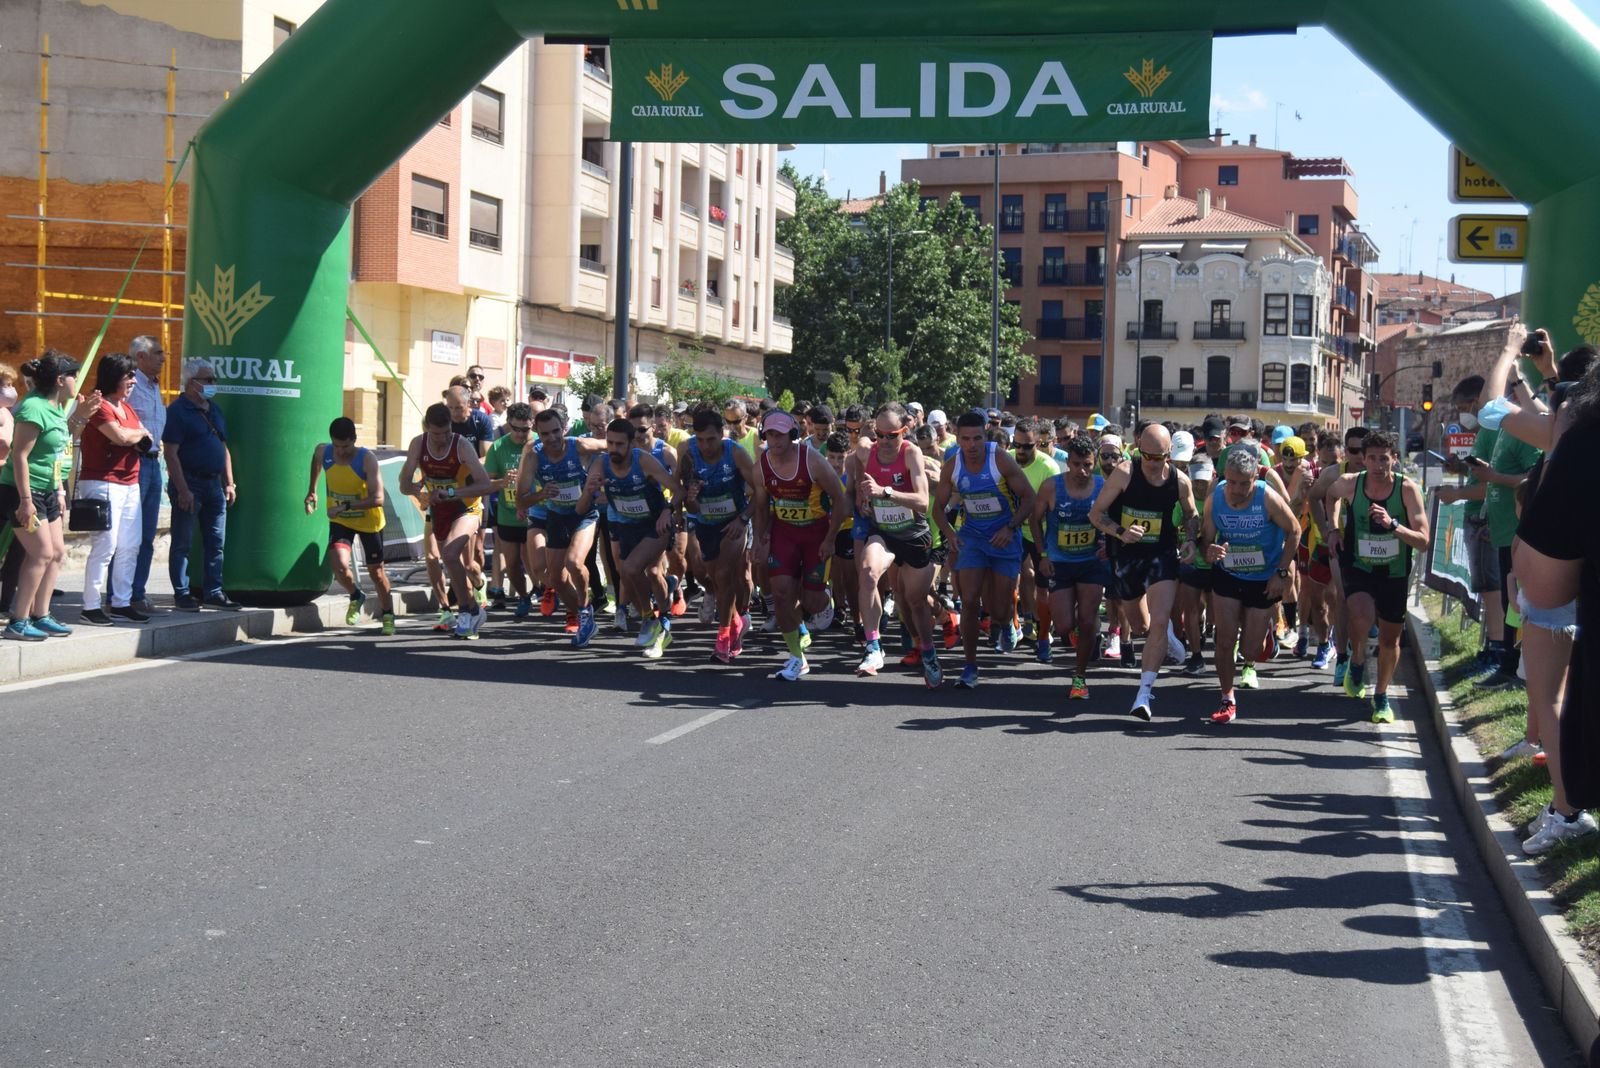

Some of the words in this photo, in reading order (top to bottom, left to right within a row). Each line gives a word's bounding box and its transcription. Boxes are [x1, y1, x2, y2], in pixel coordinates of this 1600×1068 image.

[719, 61, 1089, 120] SALIDA
[209, 356, 302, 383] RURAL
[1450, 437, 1474, 445] N-122
[780, 508, 807, 519] 227
[1065, 532, 1089, 545] 113
[1233, 557, 1256, 566] MANSO
